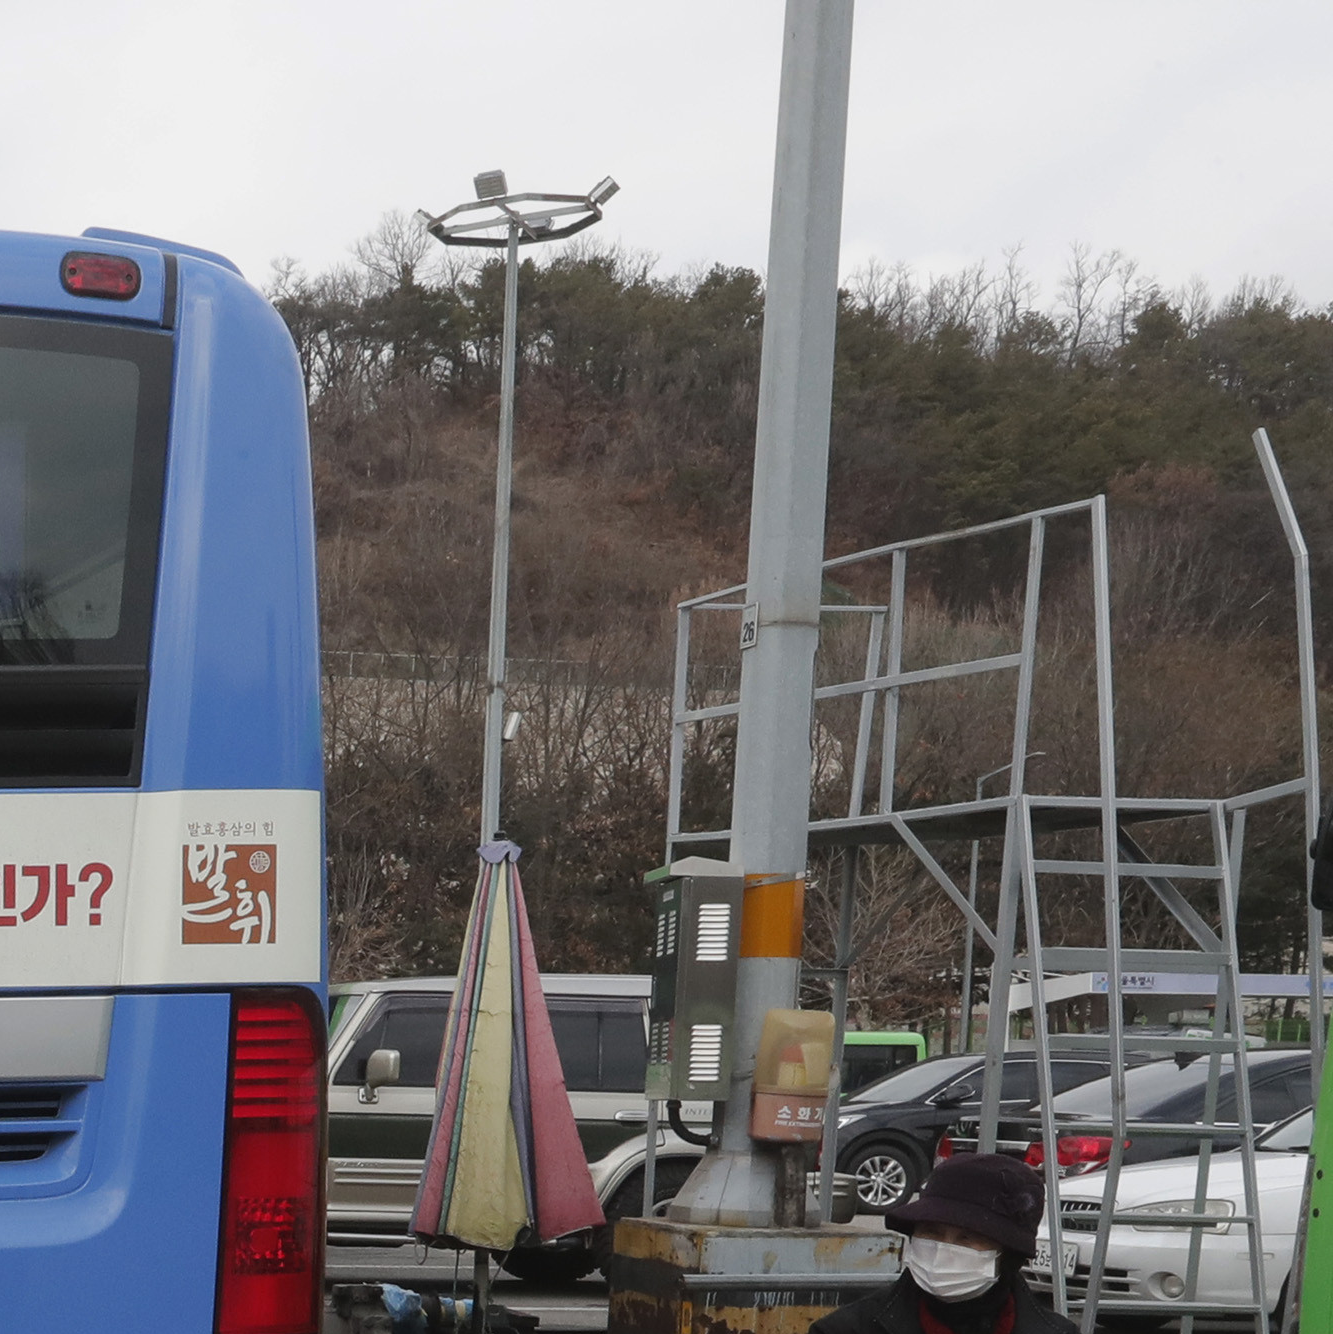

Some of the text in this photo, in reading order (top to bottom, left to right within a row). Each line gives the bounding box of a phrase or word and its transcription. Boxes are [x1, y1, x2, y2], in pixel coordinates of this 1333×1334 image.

[187, 821, 274, 837] 발효홍삼의 힘
[1121, 975, 1155, 986] 울특별시
